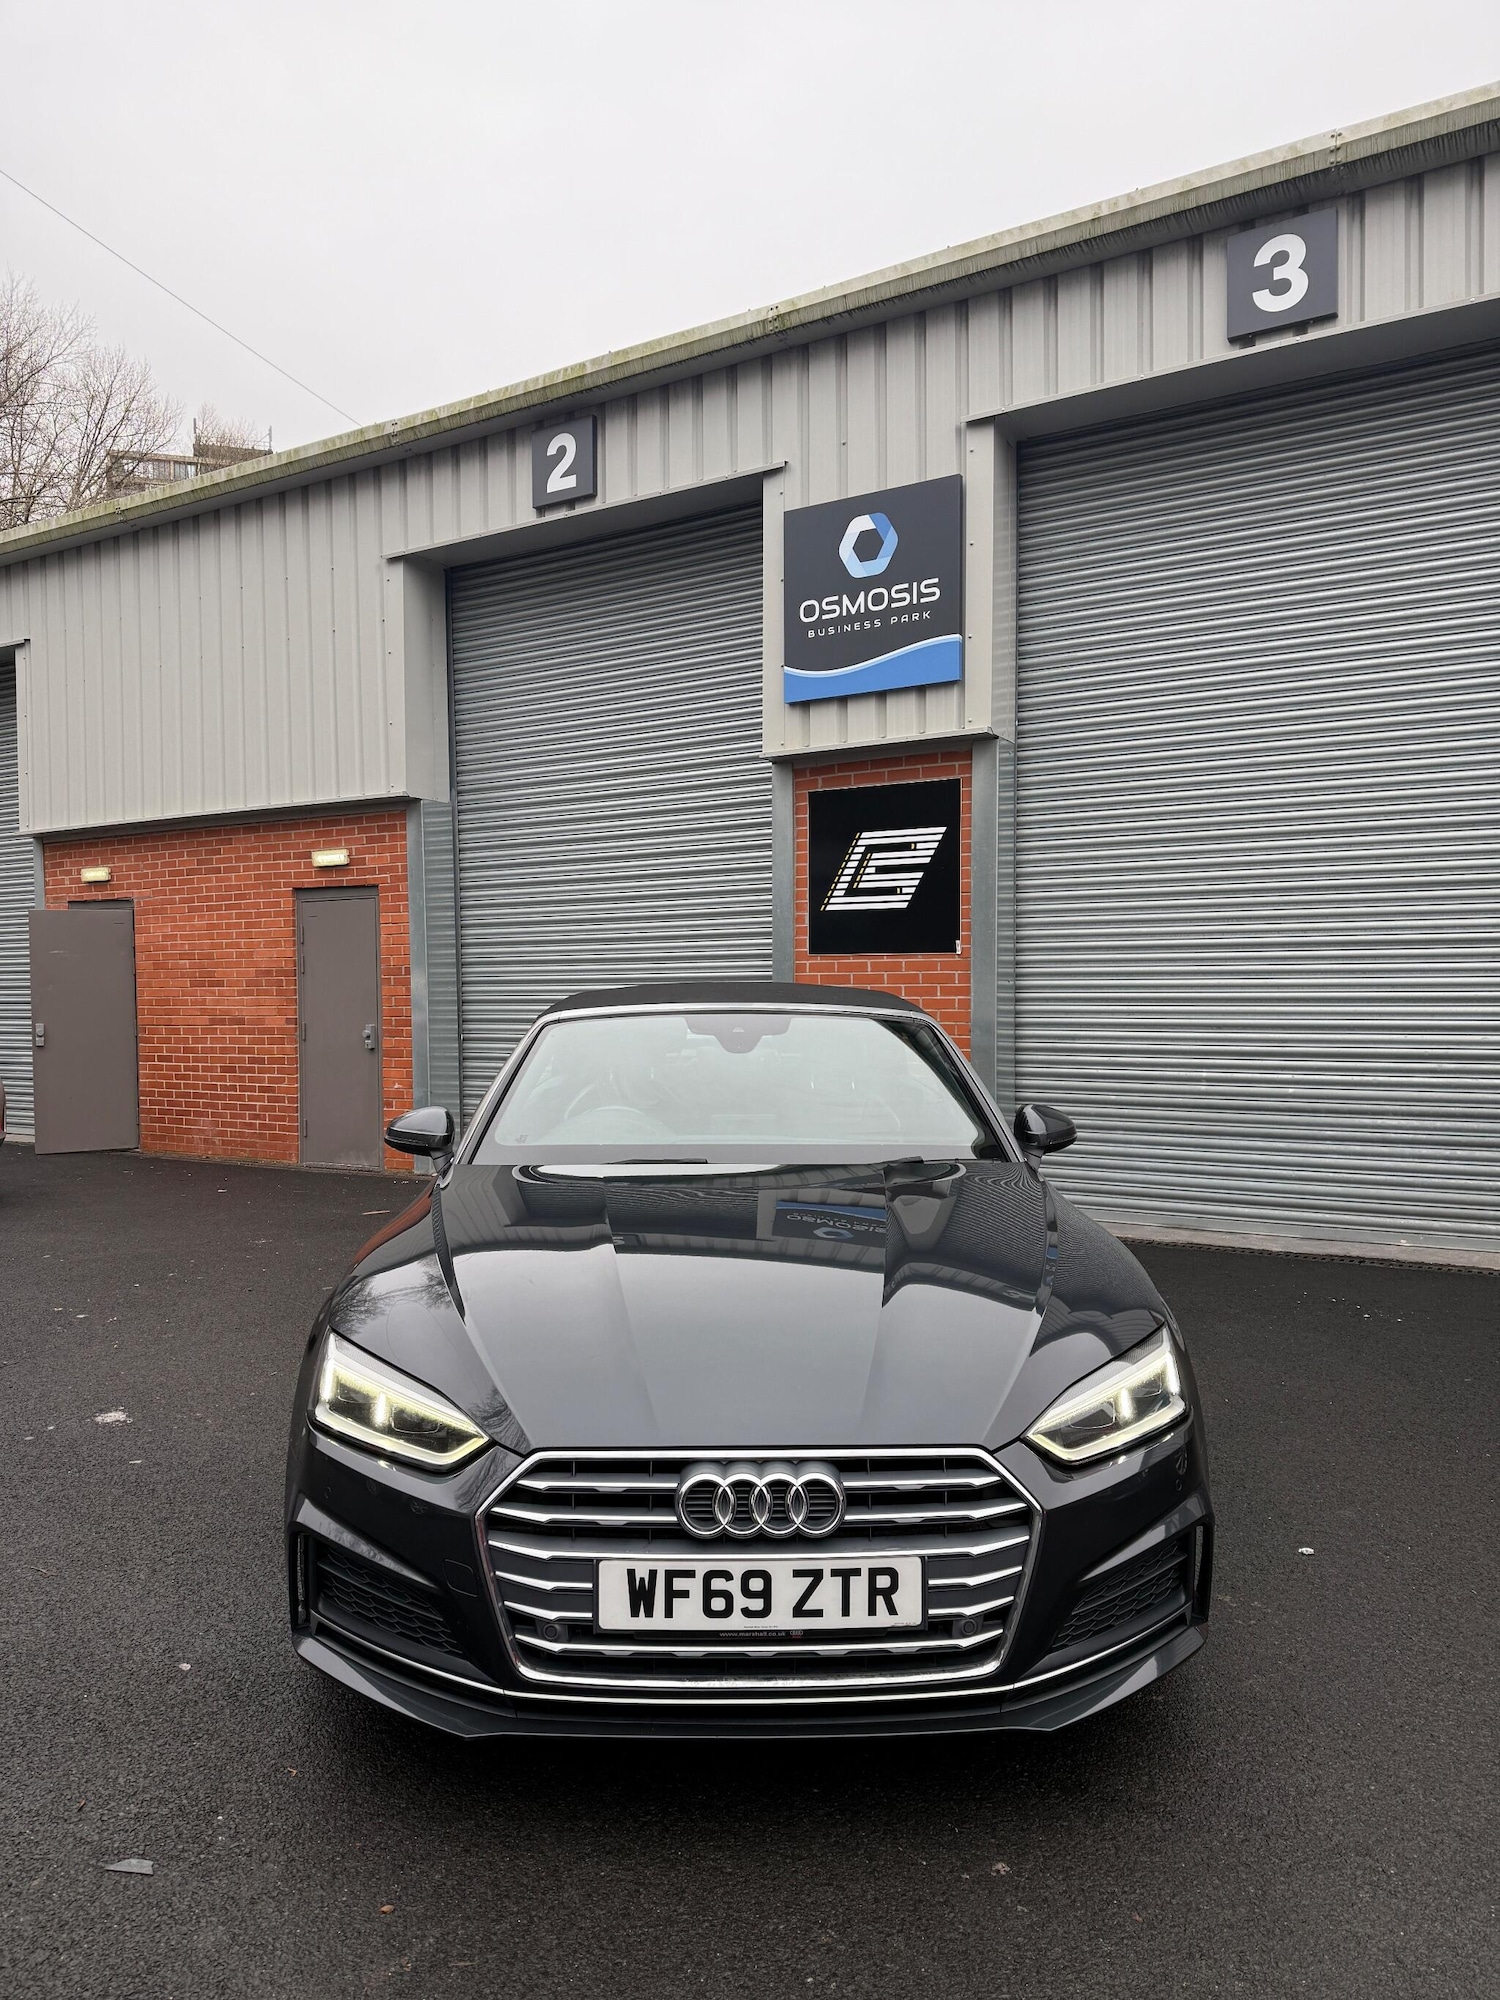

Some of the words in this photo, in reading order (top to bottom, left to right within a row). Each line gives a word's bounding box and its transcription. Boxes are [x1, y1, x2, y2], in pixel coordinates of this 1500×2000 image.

[1252, 233, 1309, 313] 3
[546, 432, 577, 494] 2
[799, 577, 941, 623] OSMOSIS
[807, 618, 882, 638] BUSINESS
[890, 610, 931, 625] PARK
[626, 1568, 772, 1619] WF69
[792, 1566, 899, 1618] ZTR
[719, 1630, 786, 1638] www.marshall.co.uk
